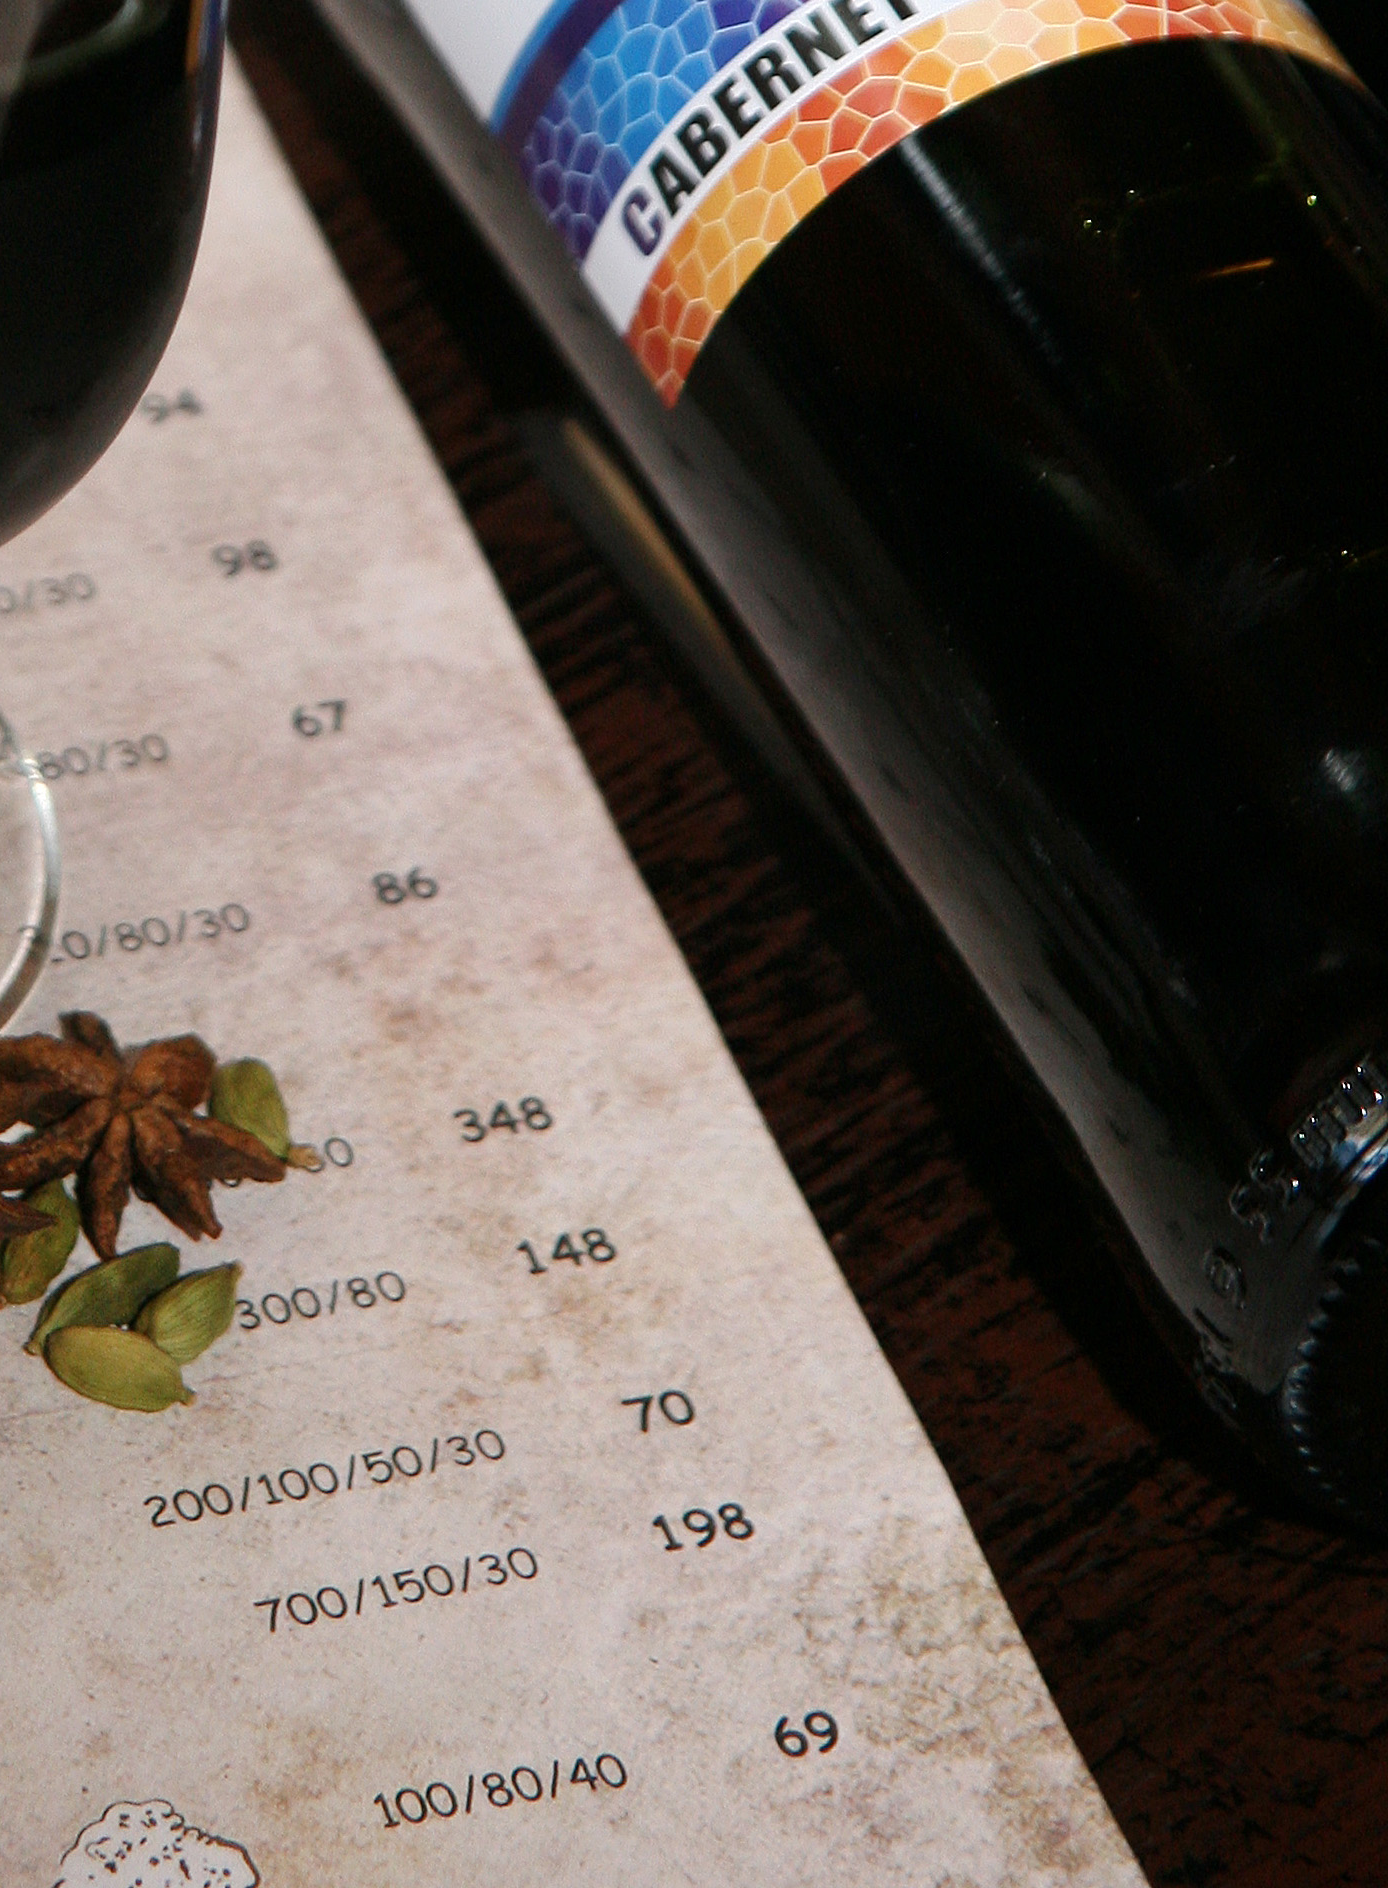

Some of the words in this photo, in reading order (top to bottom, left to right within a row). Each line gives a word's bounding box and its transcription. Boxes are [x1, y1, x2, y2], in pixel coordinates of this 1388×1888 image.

[212, 539, 279, 578] 98
[291, 698, 348, 739] 67
[372, 868, 439, 905] 86
[452, 1095, 554, 1145] 348
[517, 1227, 618, 1276] 148
[234, 1270, 407, 1329] 300/80
[620, 1388, 697, 1434] 70
[143, 1427, 508, 1530] 200/100/50/30
[650, 1502, 756, 1553] 198
[253, 1546, 541, 1634] 700/150/30
[773, 1709, 840, 1758] 69
[372, 1752, 629, 1830] 100/80/40
